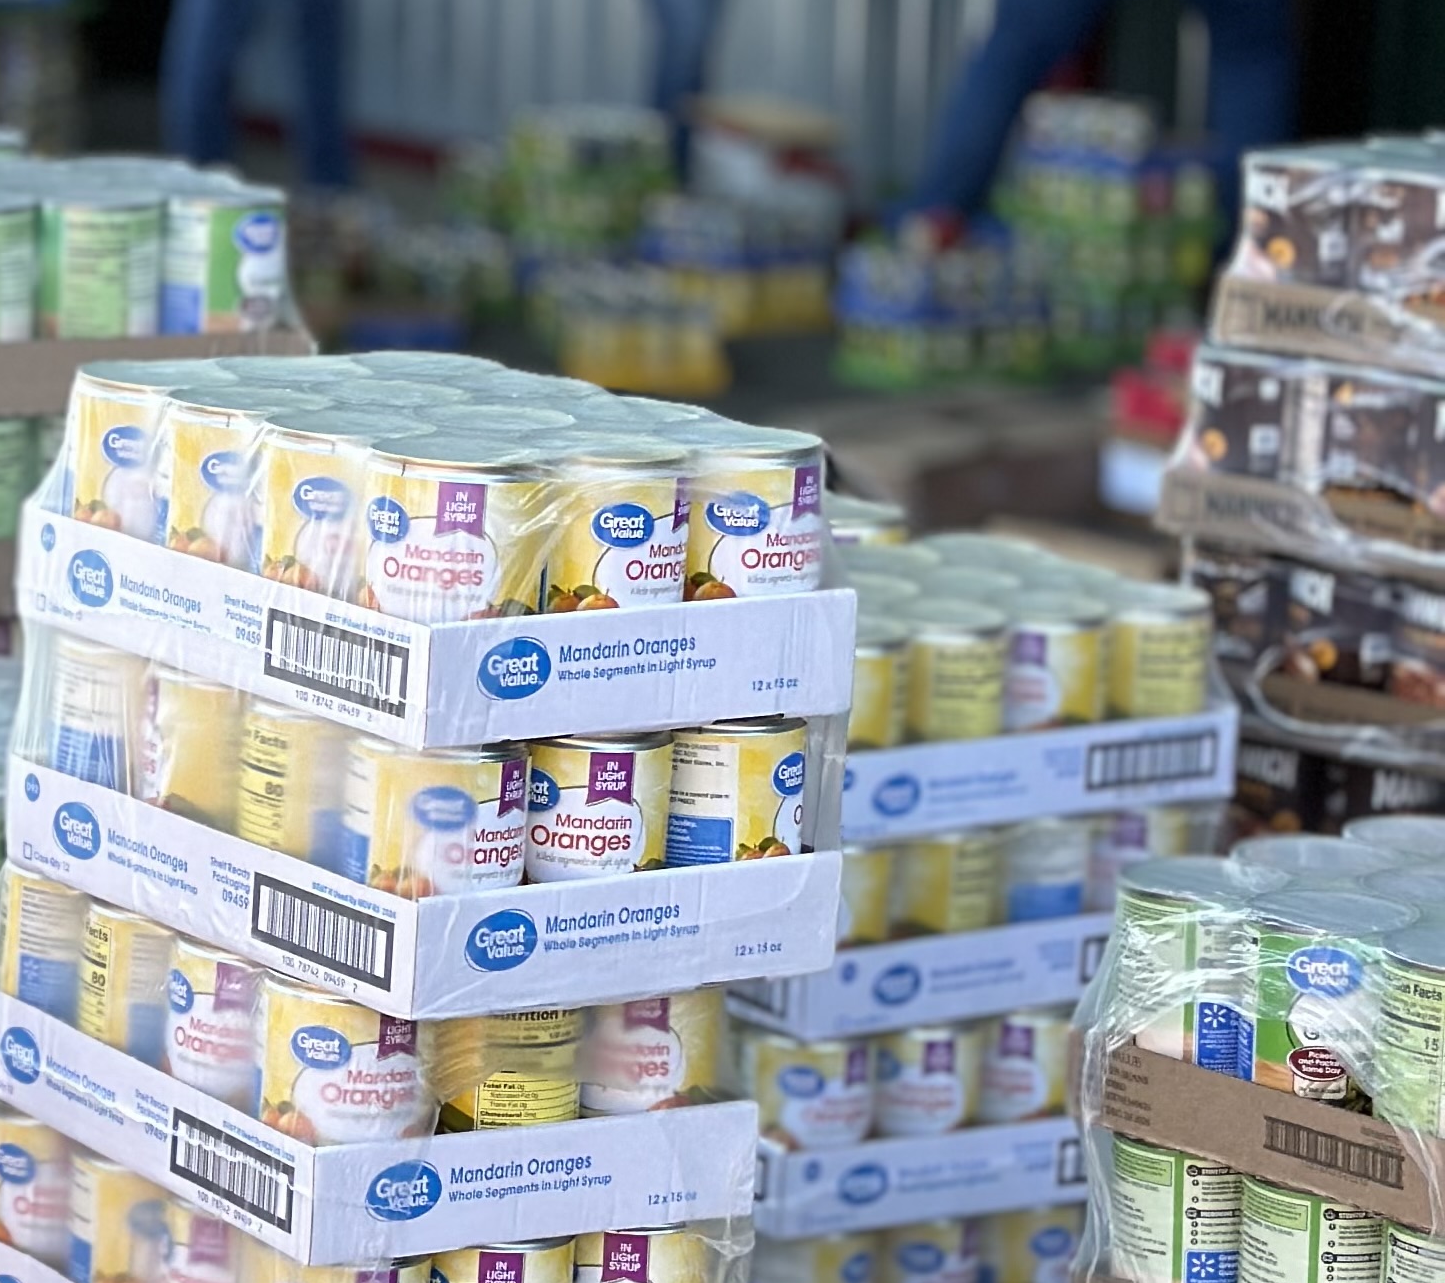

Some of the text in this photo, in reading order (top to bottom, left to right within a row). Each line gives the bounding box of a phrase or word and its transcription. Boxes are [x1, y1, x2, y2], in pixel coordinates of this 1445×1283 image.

[600, 513, 645, 531] Great
[610, 526, 645, 539] Value
[405, 544, 484, 565] Mandarin
[72, 560, 106, 587] Great
[383, 558, 484, 588] Oranges
[235, 627, 261, 645] 09459
[559, 635, 696, 663] Mandarin Oranges
[486, 652, 539, 678] Great
[557, 667, 590, 682] Whole
[592, 663, 645, 680] Segments
[658, 658, 684, 674] Light
[687, 656, 717, 673] Syrup
[500, 670, 538, 688] Value
[752, 680, 762, 692] 12
[764, 682, 771, 690] x
[787, 677, 798, 689] oz
[295, 689, 372, 722] 100 78742 09459 2
[597, 769, 625, 782] LIGHT
[607, 761, 618, 770] IN
[59, 812, 94, 838] Great
[555, 813, 632, 830] Mandarin
[67, 832, 93, 851] Value
[530, 823, 631, 856] Oranges
[222, 889, 249, 909] 09459
[546, 903, 680, 934] Mandarin Oranges
[474, 926, 526, 950] Great
[544, 937, 576, 952] Whole
[579, 934, 630, 950] Segments
[643, 929, 668, 944] Light
[671, 924, 700, 941] Syrup
[487, 943, 525, 960] Value
[735, 945, 745, 957] 12
[747, 946, 754, 955] x
[770, 943, 782, 952] oz
[1295, 956, 1349, 978] Great
[297, 1033, 340, 1053] Great
[450, 1154, 592, 1184] Mandarin Oranges
[375, 1178, 428, 1202] Great
[449, 1174, 611, 1203] Whole Segments in Light Syrup
[648, 1194, 659, 1206] 12
[661, 1196, 669, 1204] x
[670, 1191, 683, 1203] 15
[620, 1242, 632, 1252] IN
[486, 1269, 516, 1281] LIGHT
[495, 1261, 507, 1271] IN
